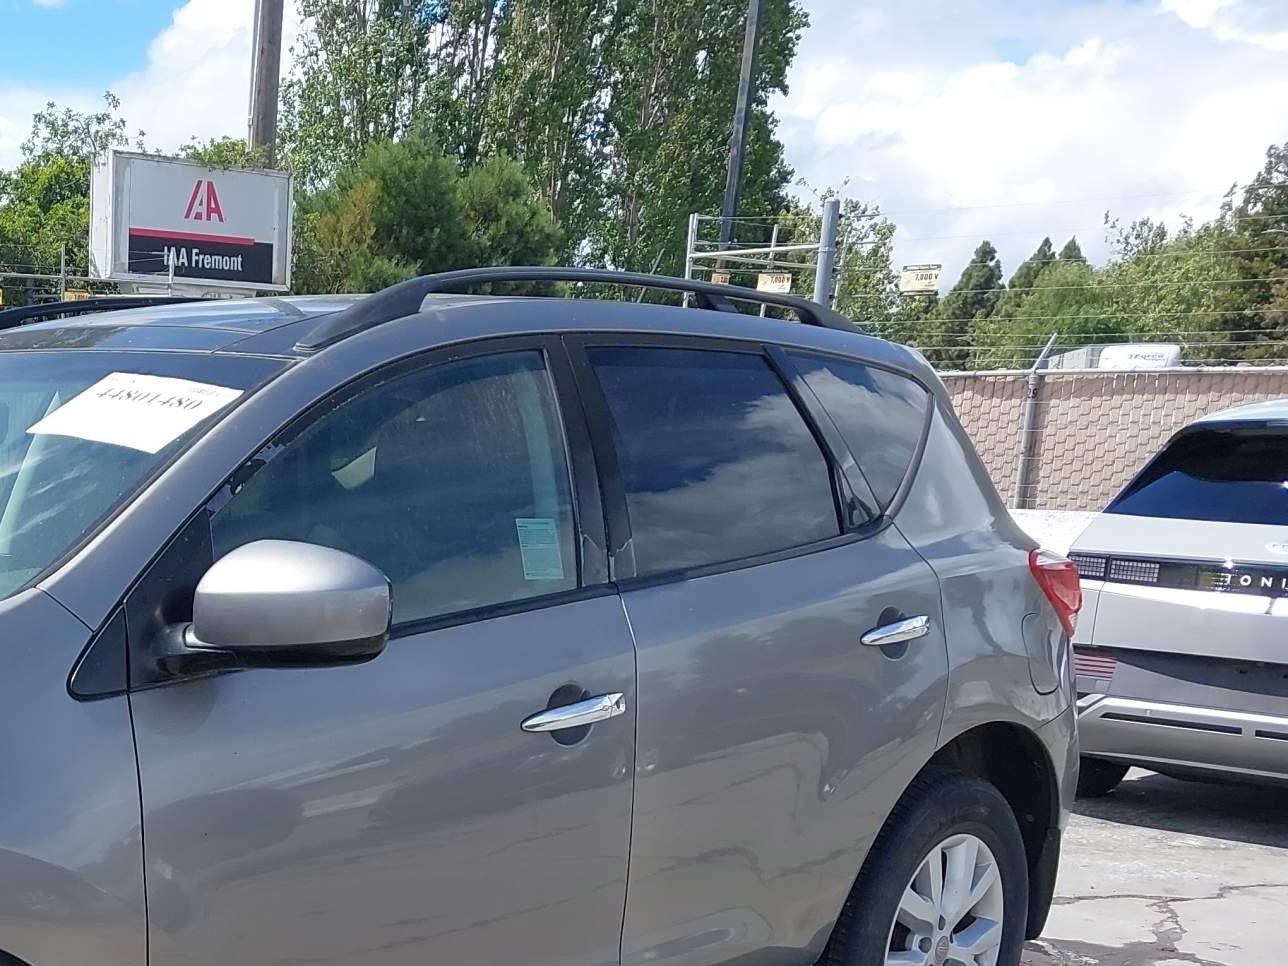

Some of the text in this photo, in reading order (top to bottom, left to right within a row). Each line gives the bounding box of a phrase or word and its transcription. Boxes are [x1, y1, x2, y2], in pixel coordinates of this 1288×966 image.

[163, 246, 243, 272] IAA Fremont
[96, 388, 203, 410] 44801480
